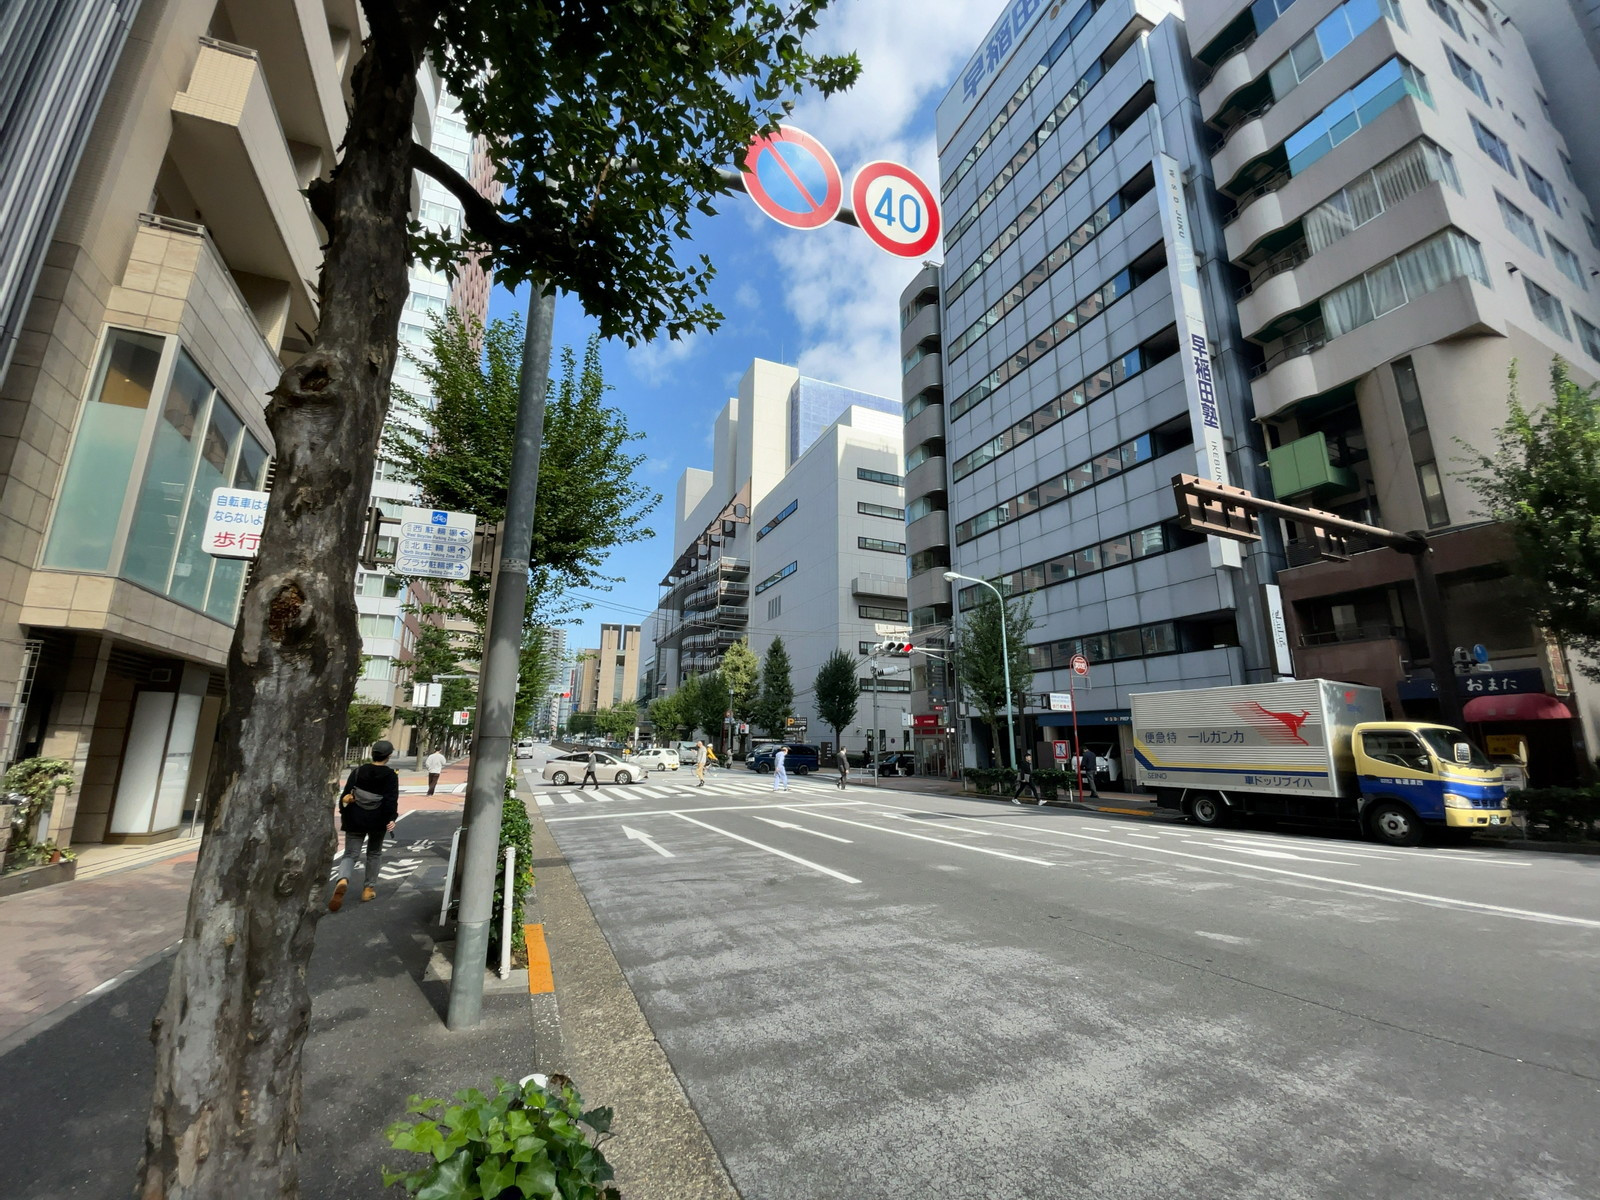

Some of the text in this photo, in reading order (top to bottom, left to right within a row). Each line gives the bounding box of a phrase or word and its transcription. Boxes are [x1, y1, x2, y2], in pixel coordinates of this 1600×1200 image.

[874, 187, 921, 233] 40
[1175, 210, 1185, 239] JUKU
[1191, 333, 1219, 429] 早稲田塾
[1211, 440, 1224, 485] IKEBUK
[1466, 678, 1518, 692] おまた
